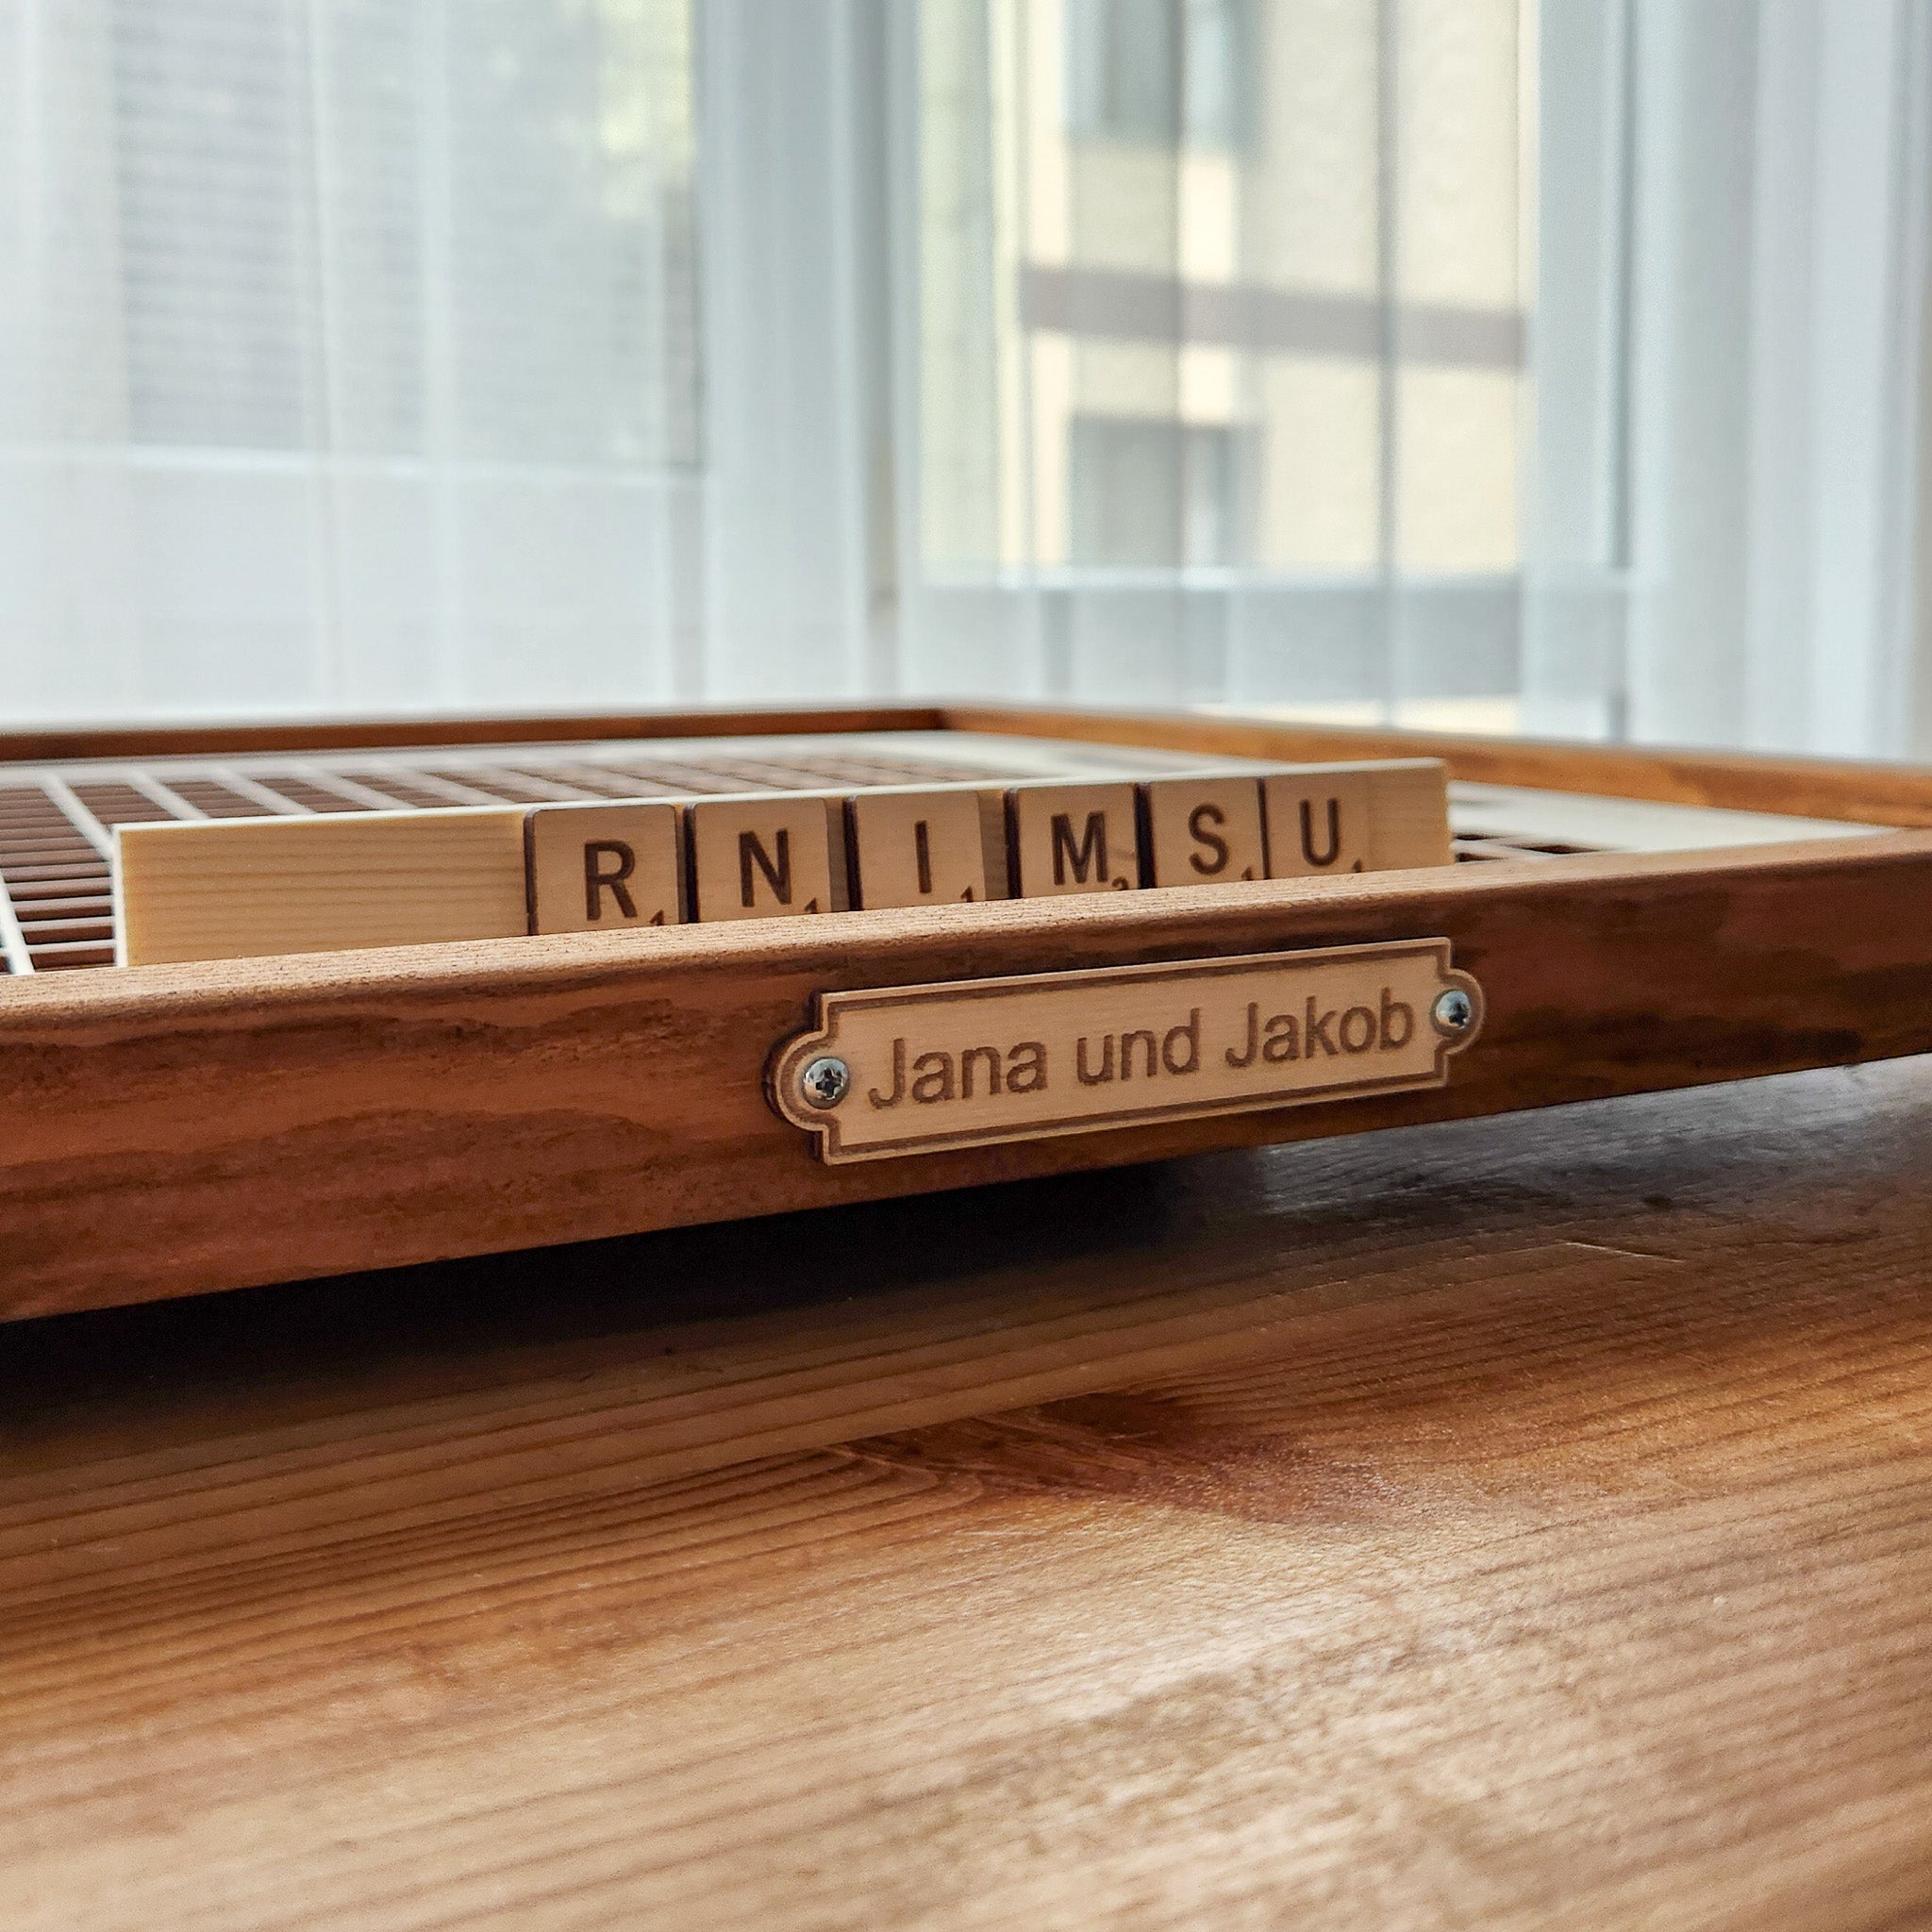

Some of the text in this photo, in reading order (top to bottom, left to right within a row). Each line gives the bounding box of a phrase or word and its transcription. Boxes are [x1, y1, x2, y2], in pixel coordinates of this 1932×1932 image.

[584, 797, 1340, 921] R N I M S U
[868, 987, 1415, 1110] Jana und Jakob
